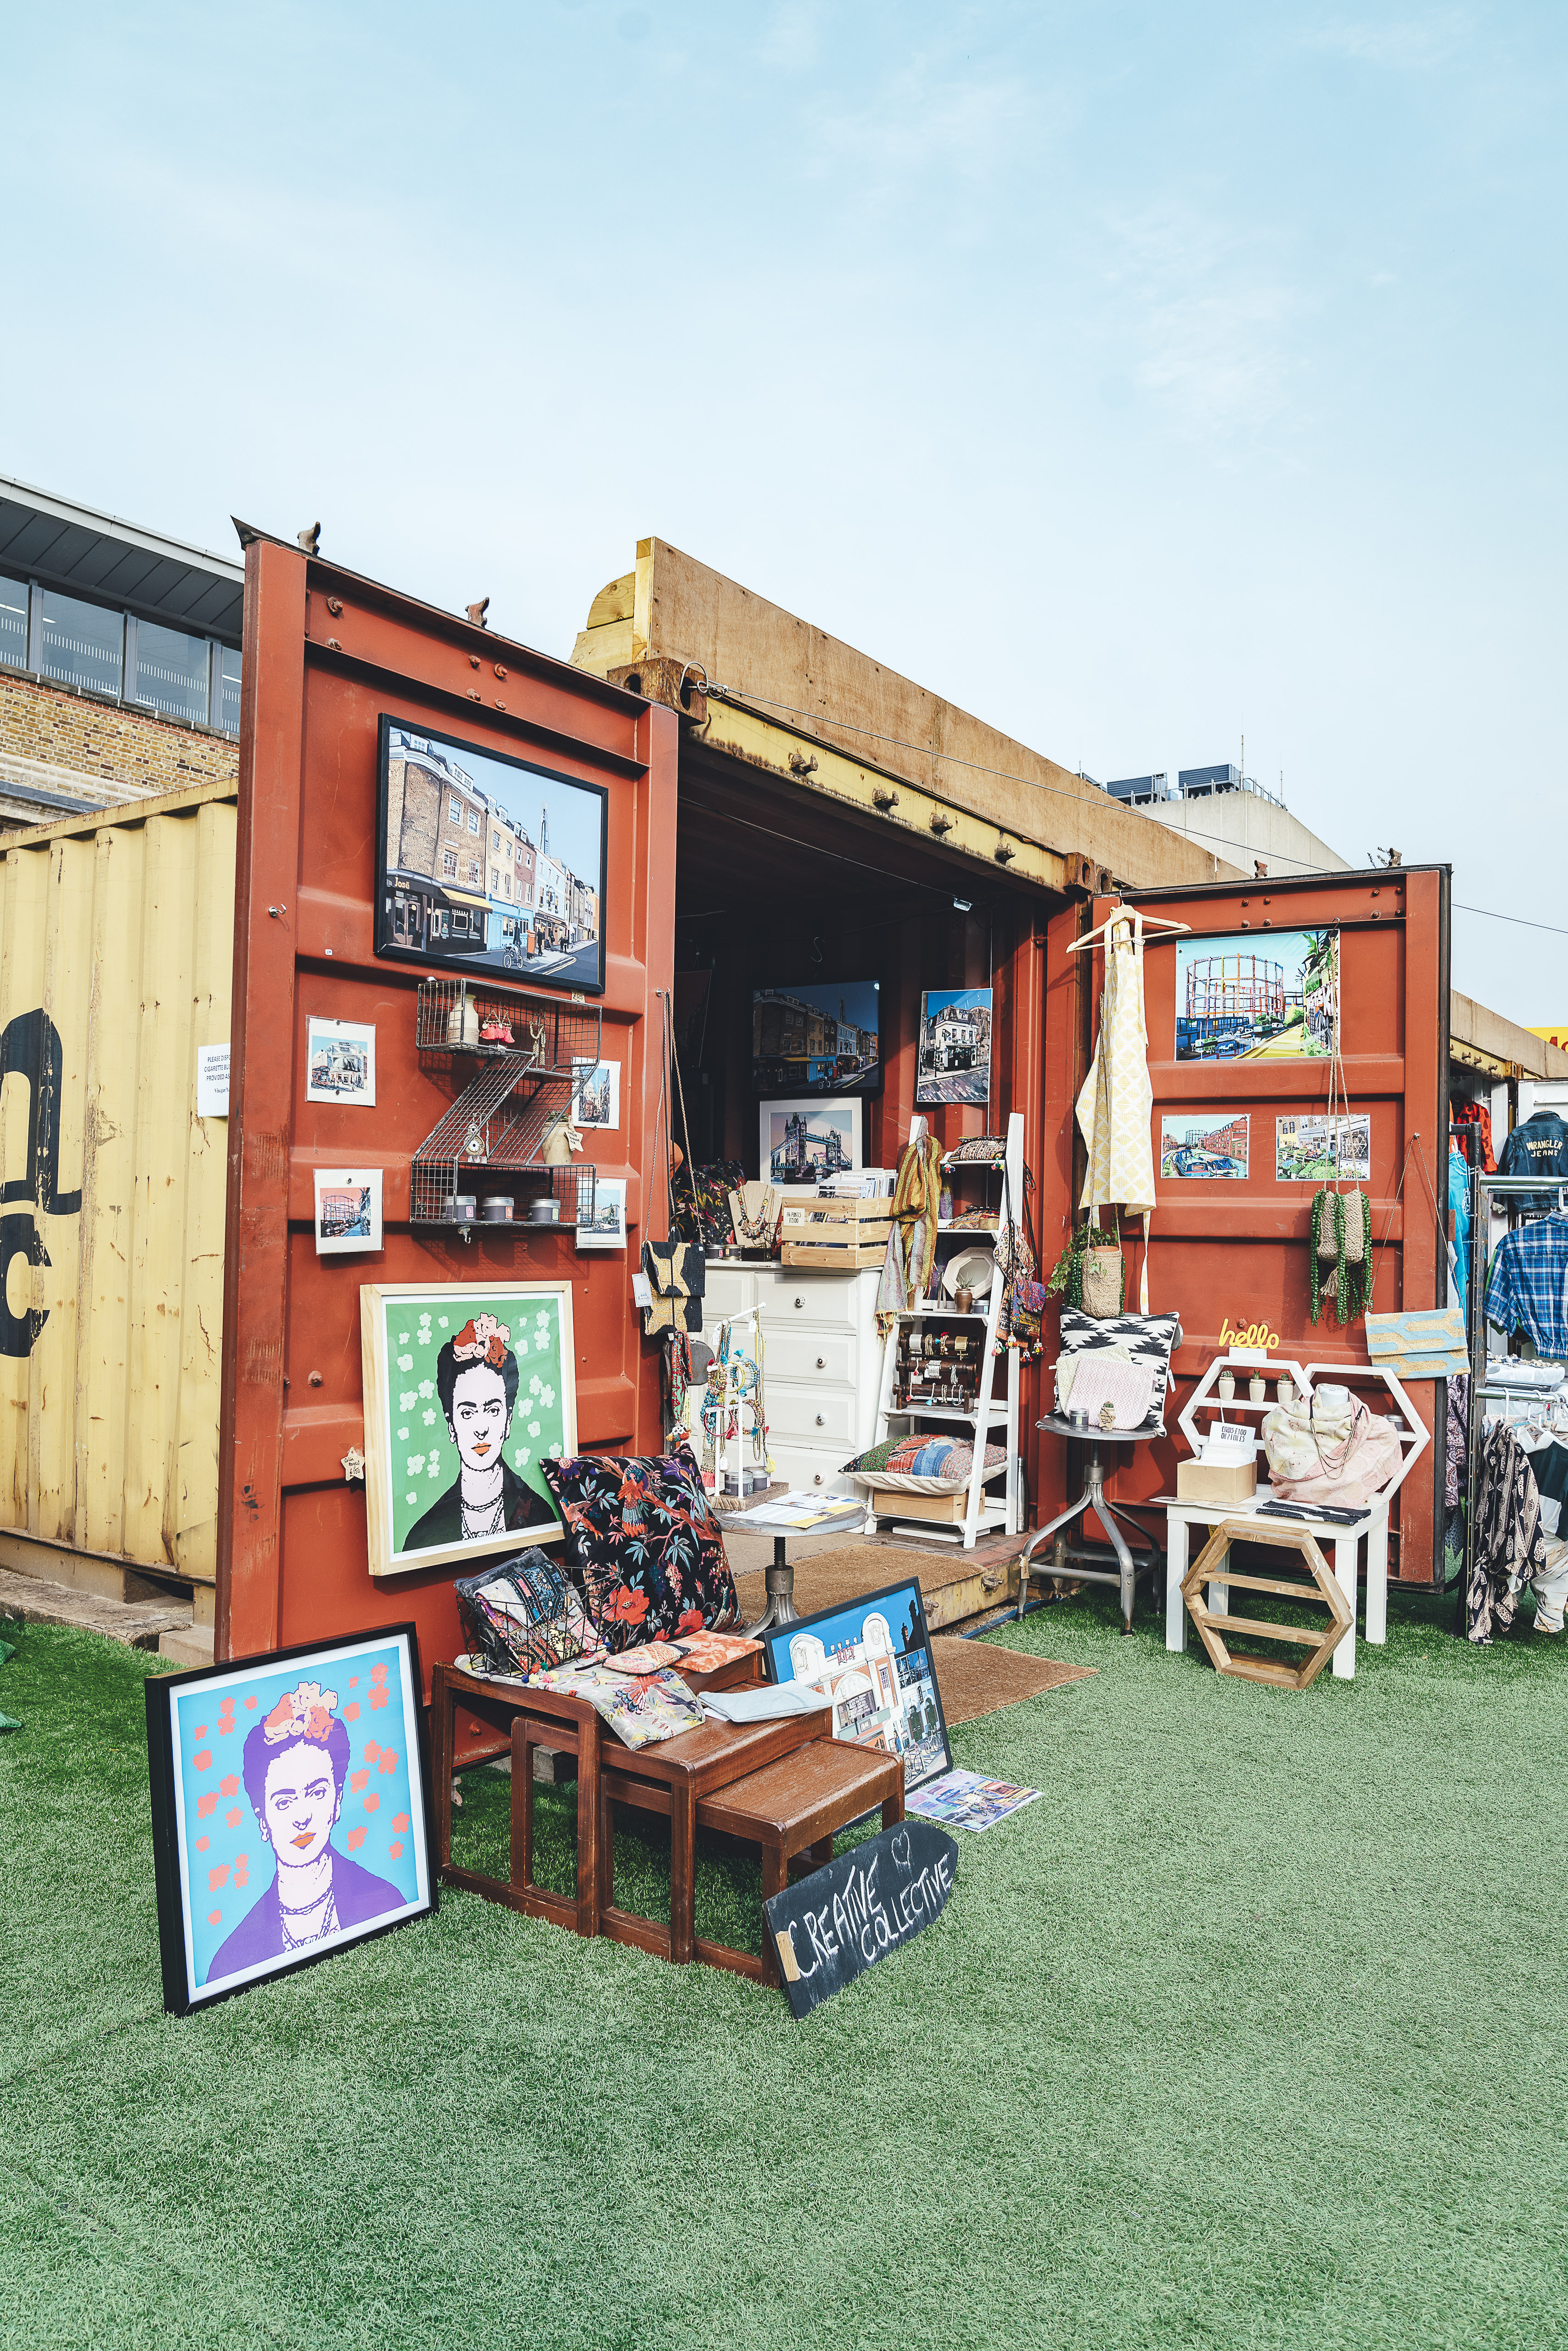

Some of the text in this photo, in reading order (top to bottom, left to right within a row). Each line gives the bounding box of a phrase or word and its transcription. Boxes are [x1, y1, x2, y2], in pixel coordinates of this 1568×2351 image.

[394, 876, 410, 889] José
[1526, 1139, 1563, 1151] WRANGLER
[1218, 1318, 1280, 1350] hello
[349, 1468, 360, 1477] £150
[786, 1854, 881, 1978] CREATIVE
[861, 1852, 953, 1961] COLLECTIVE
